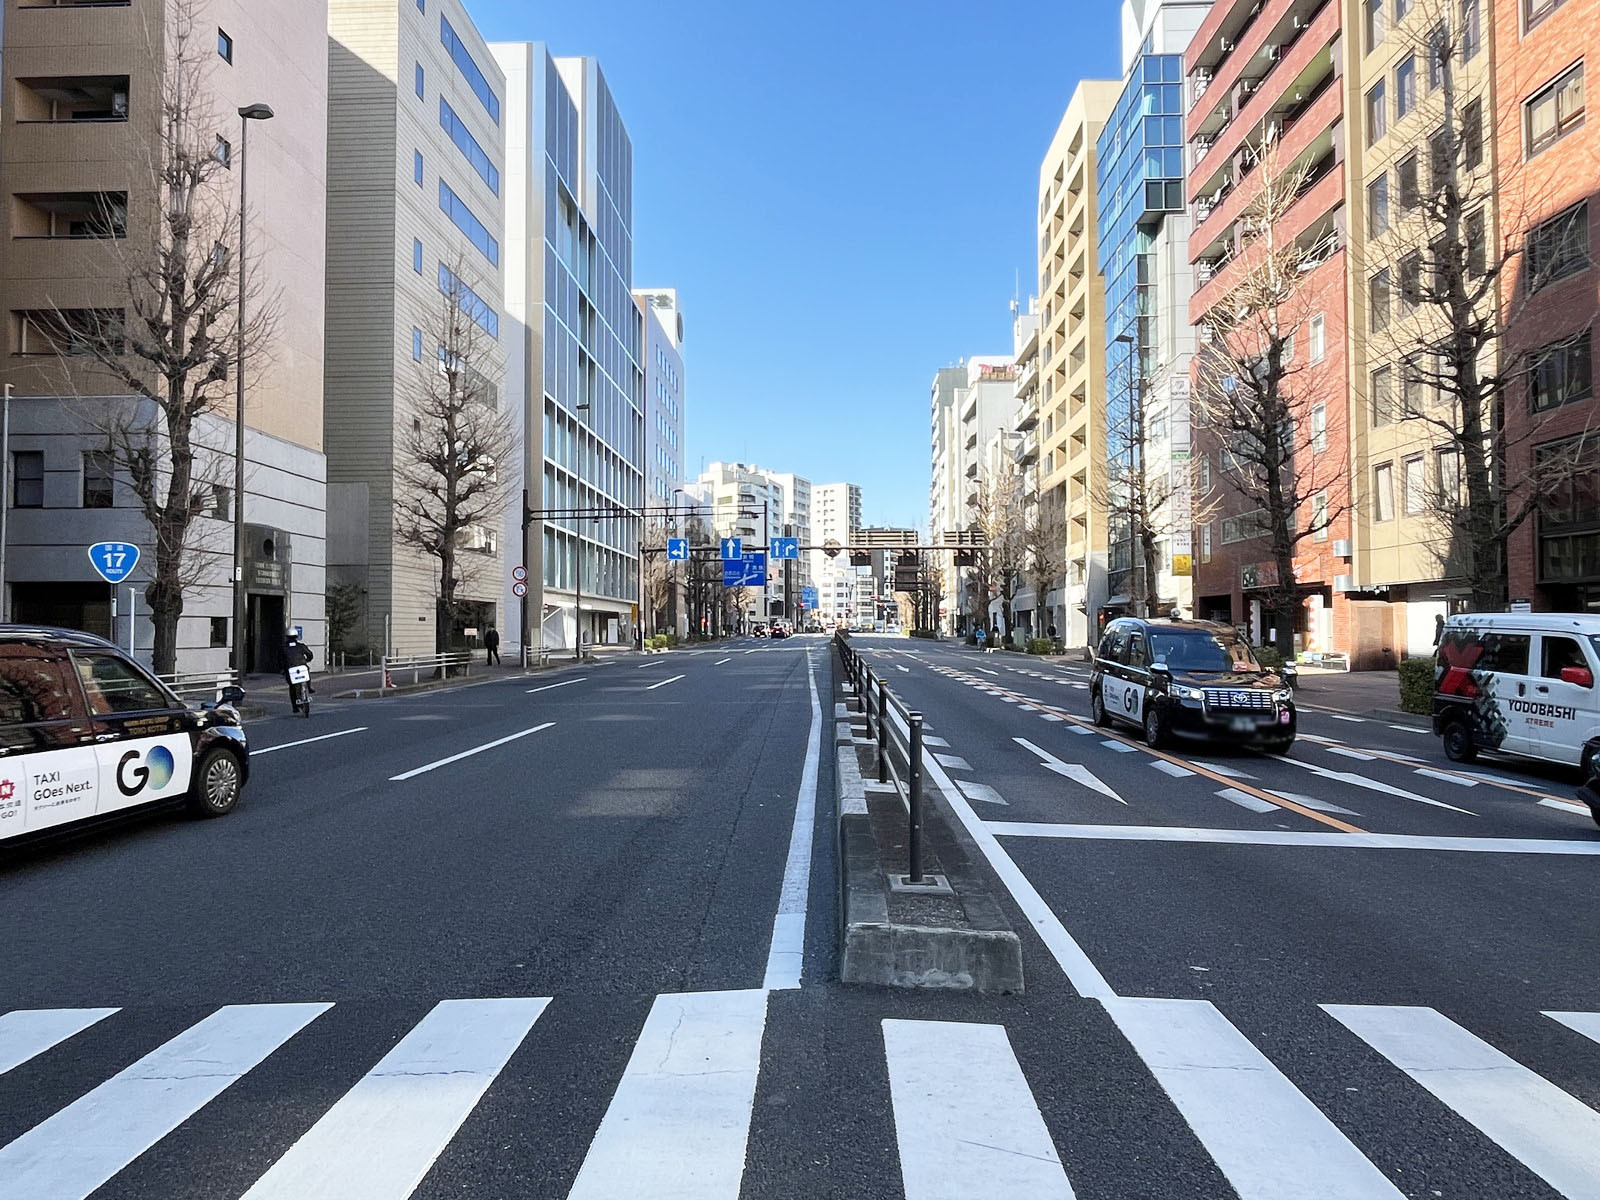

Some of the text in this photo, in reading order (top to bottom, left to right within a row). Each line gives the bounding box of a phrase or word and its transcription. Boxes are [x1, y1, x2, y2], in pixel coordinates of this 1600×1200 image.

[103, 552, 126, 568] 17
[1508, 699, 1576, 720] YODOBASHI
[34, 771, 60, 785] TAXI
[116, 745, 175, 797] GO
[34, 780, 93, 801] GOes Next.
